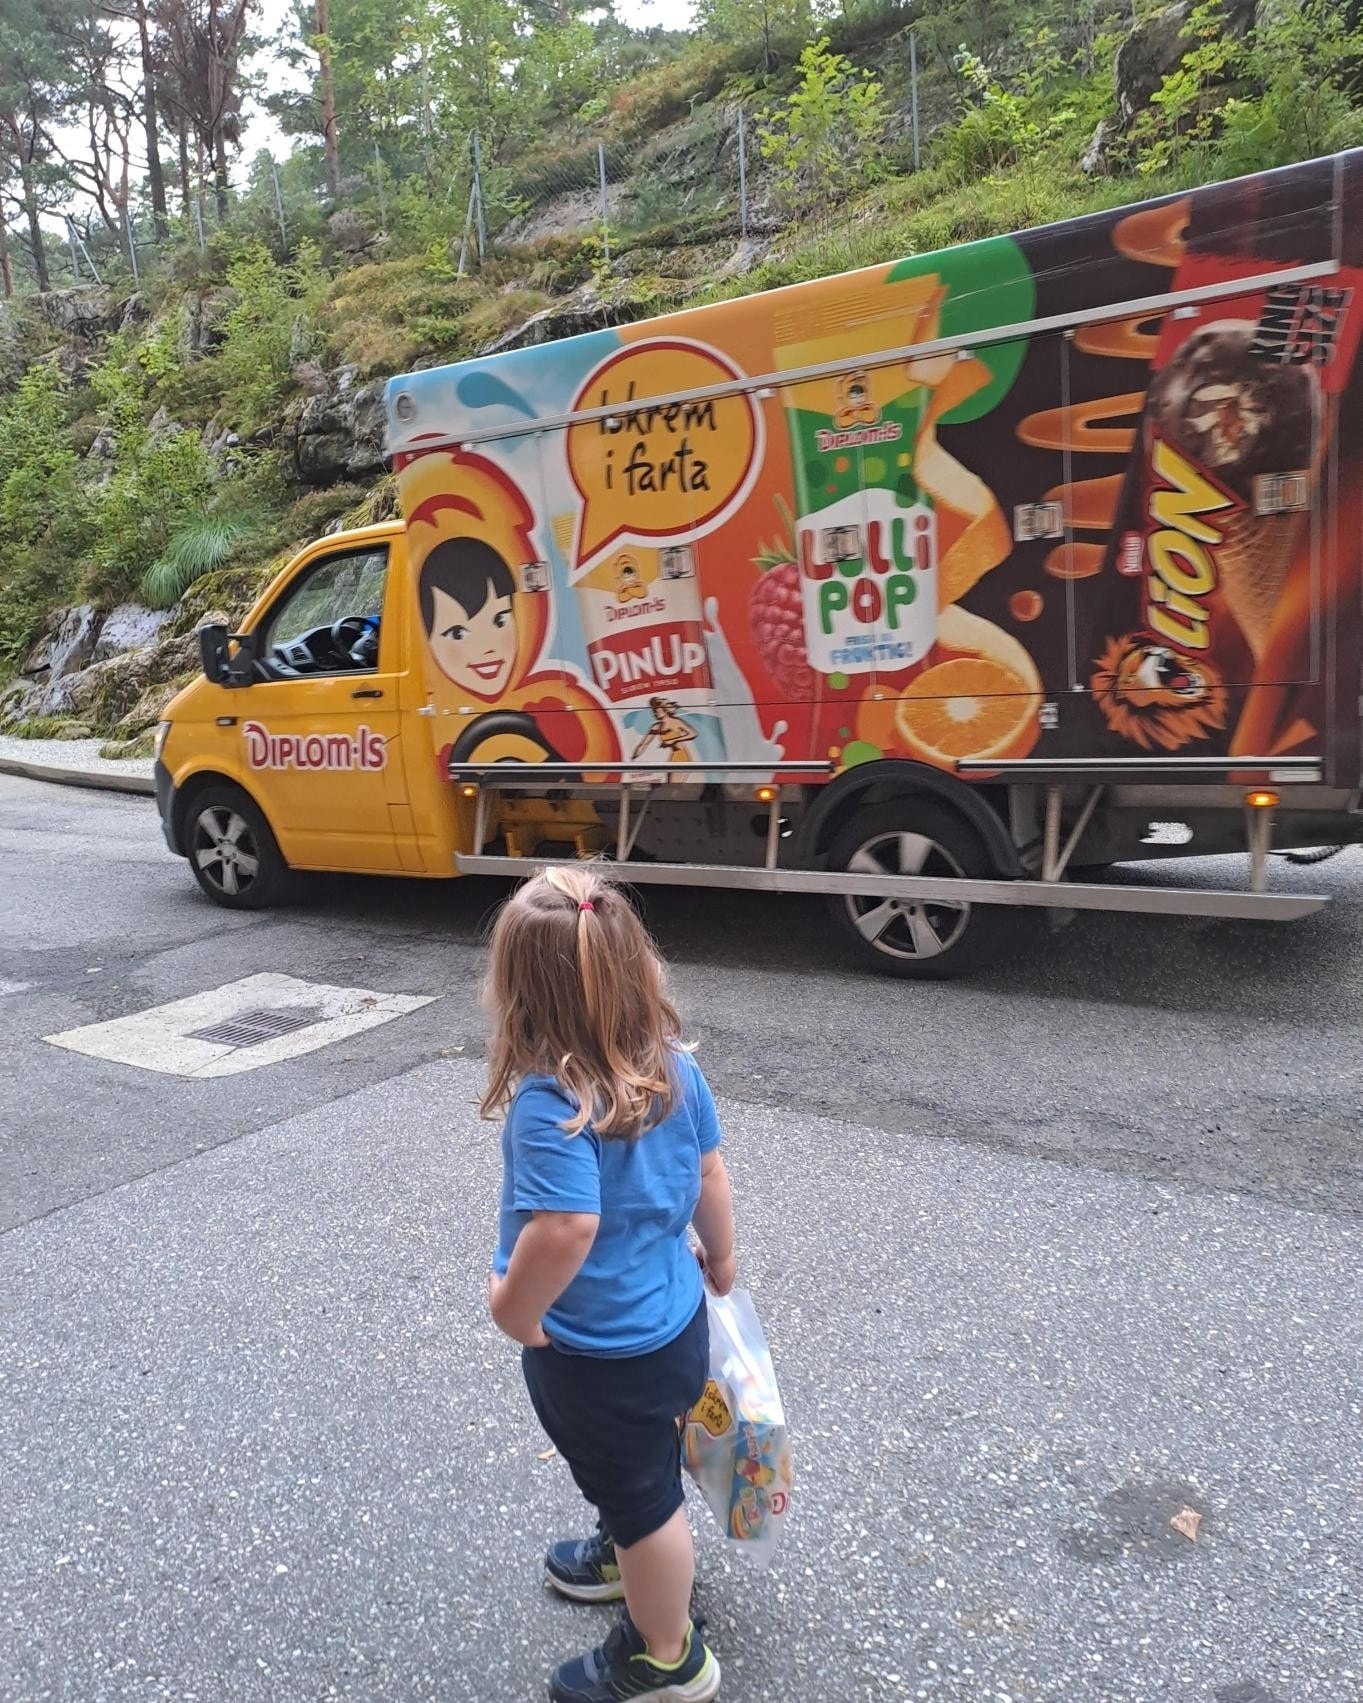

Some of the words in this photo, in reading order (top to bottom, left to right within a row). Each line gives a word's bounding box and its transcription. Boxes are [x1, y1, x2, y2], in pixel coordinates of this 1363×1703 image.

[605, 449, 614, 490] i
[622, 437, 711, 496] farta
[820, 573, 917, 635] POP
[591, 633, 706, 690] PINUP
